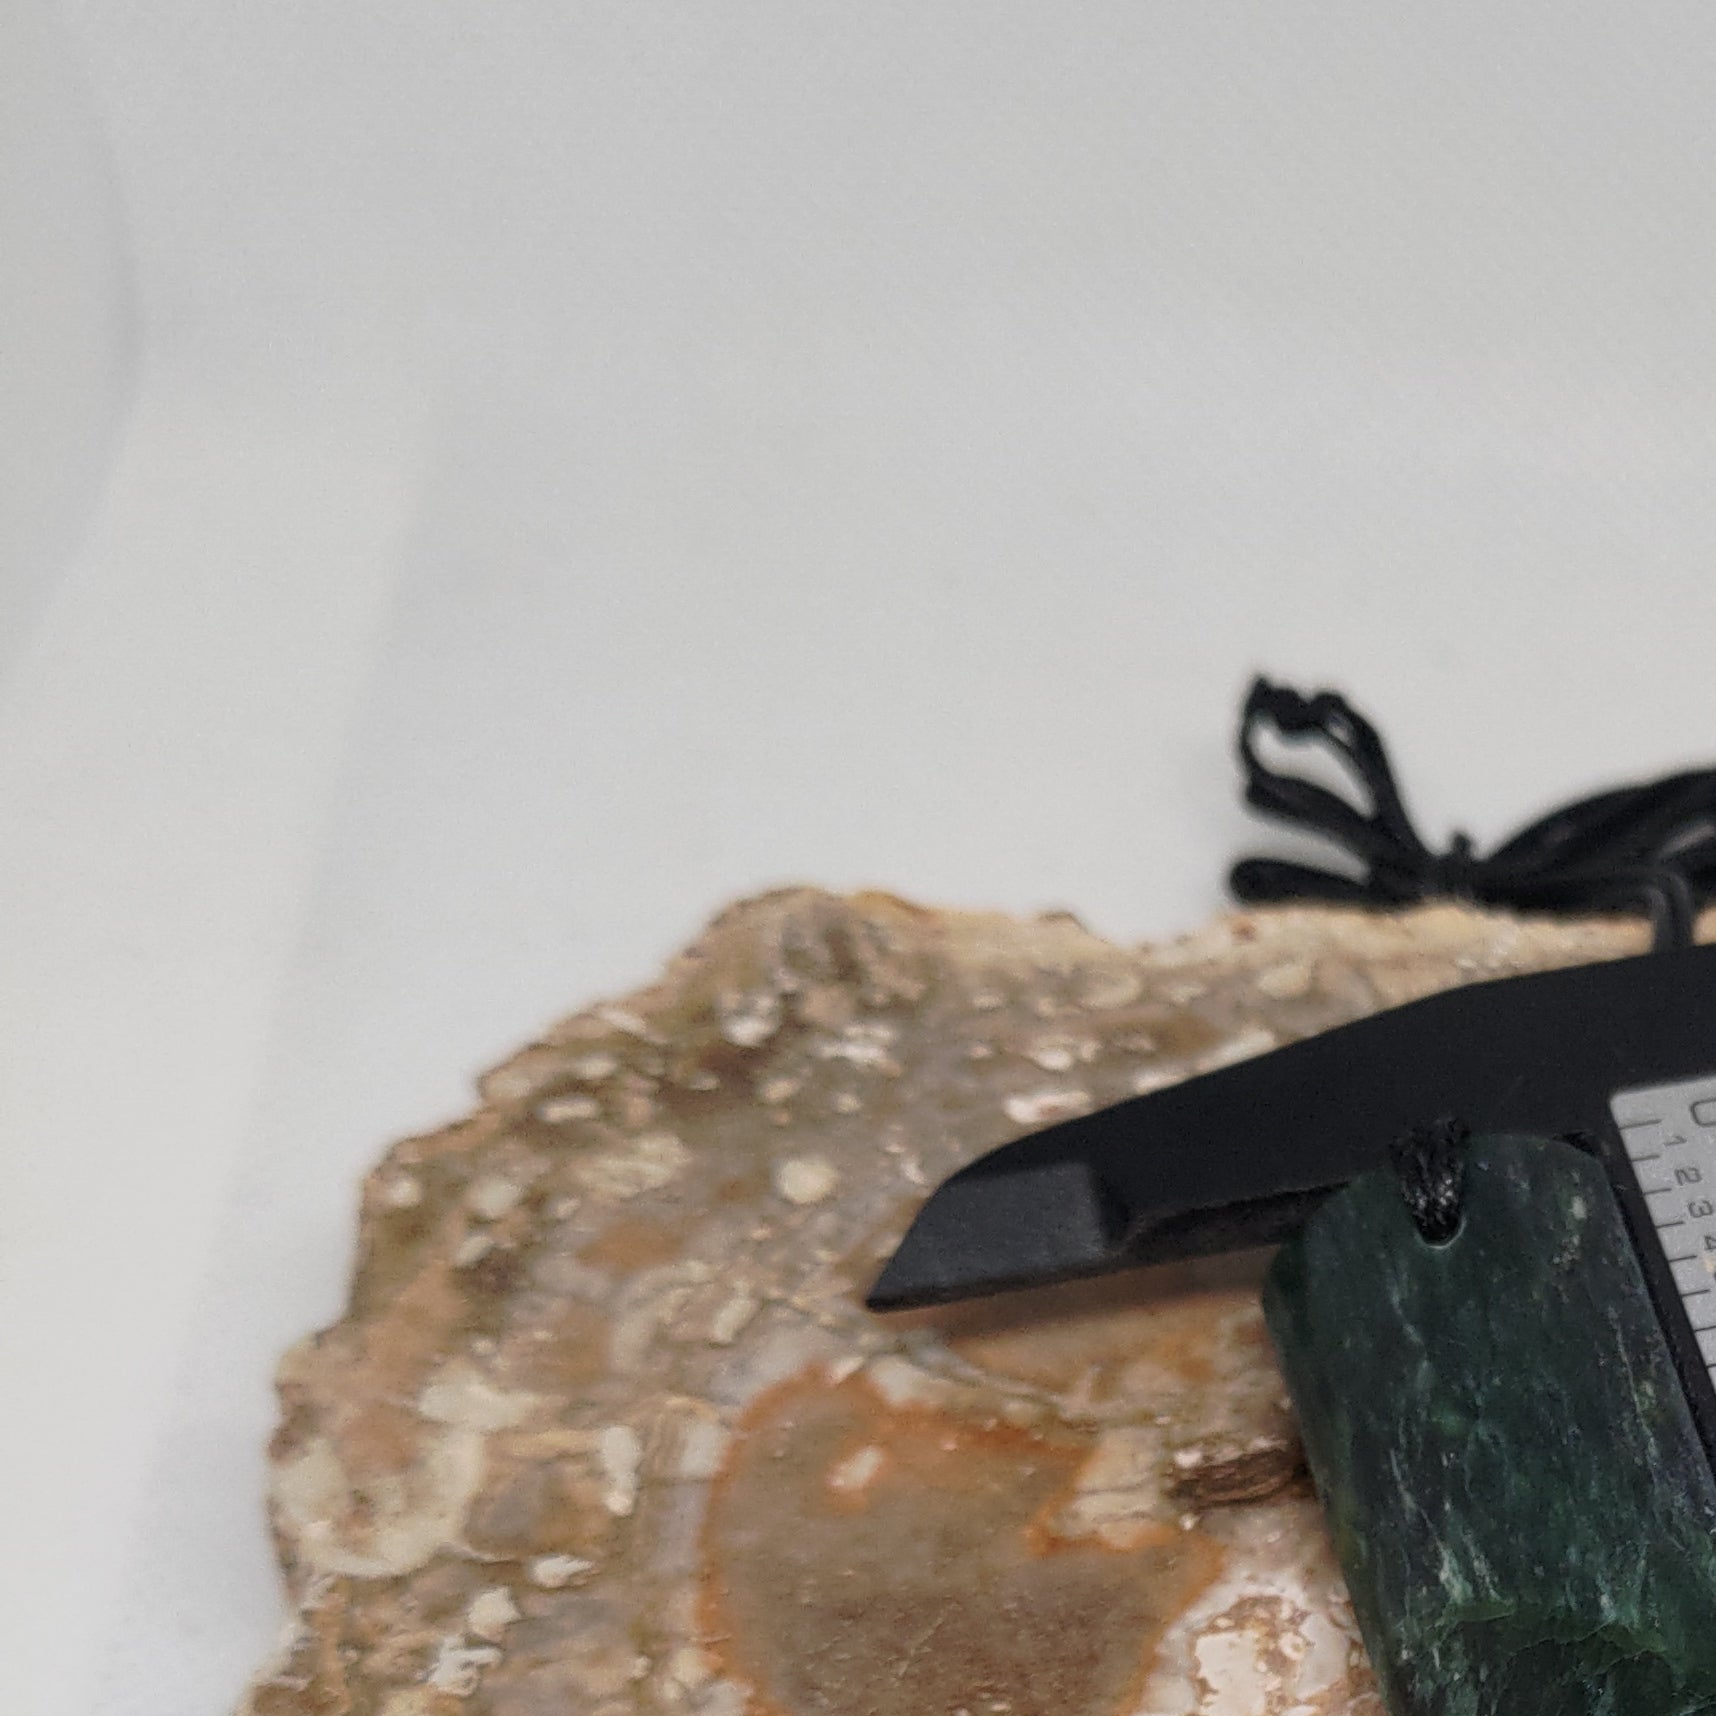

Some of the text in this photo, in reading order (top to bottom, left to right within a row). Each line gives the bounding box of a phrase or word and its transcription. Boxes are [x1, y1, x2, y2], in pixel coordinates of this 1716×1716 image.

[1664, 1135, 1686, 1147] 1
[1675, 1167, 1702, 1185] 2
[1688, 1200, 1714, 1218] 3
